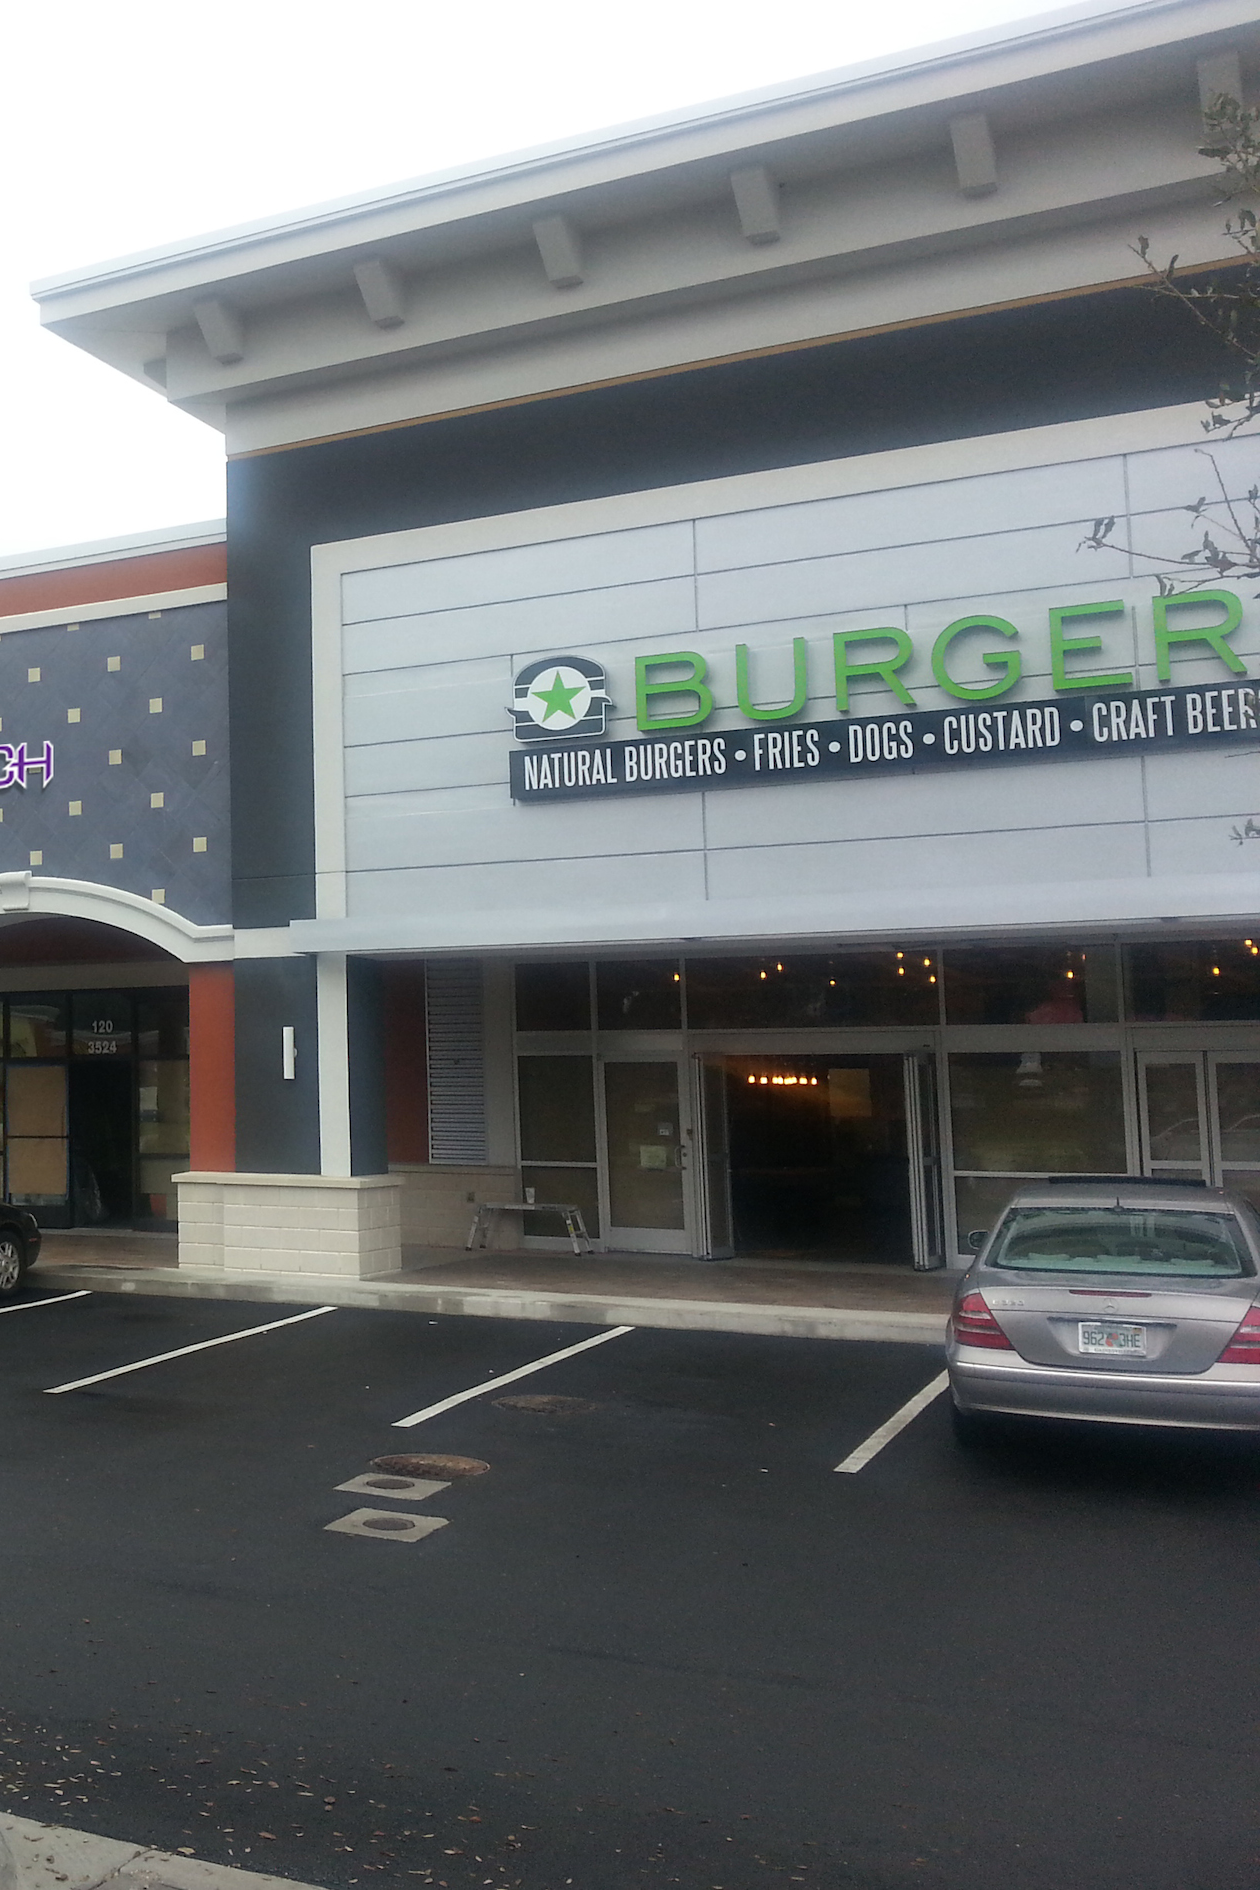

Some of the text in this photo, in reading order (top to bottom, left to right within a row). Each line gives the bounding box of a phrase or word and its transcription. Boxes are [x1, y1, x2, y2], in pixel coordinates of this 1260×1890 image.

[633, 587, 1249, 733] BURGER
[524, 687, 1260, 791] NATURAL BURGERS FRIES DOGS CUSTARD CRAFT BEER
[92, 1020, 114, 1033] 120
[88, 1040, 117, 1054] 3524
[1082, 1330, 1105, 1347] 962
